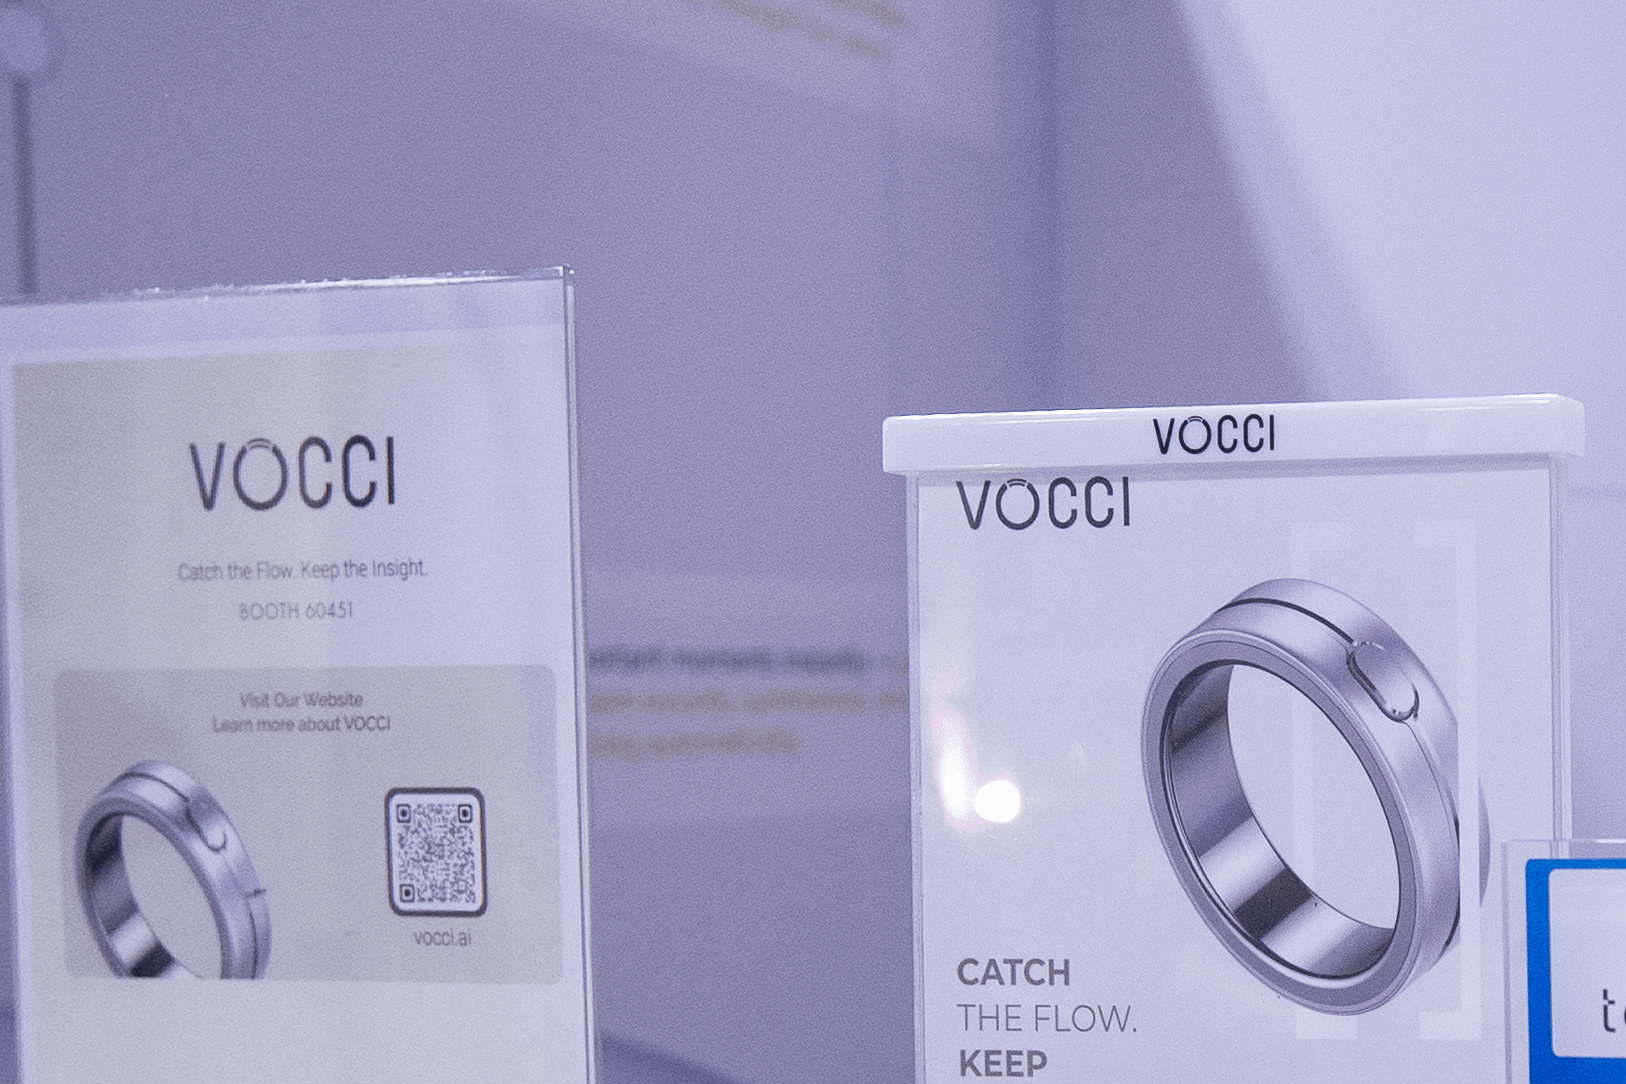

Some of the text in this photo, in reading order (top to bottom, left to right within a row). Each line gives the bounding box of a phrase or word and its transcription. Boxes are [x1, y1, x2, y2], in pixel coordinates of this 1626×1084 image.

[1153, 413, 1276, 455] VOCCI
[190, 434, 396, 511] VOCCI
[955, 475, 1130, 531] VOCCI
[178, 561, 223, 581] Catch
[228, 560, 252, 580] the
[300, 560, 340, 582] Keep
[343, 558, 368, 578] the
[239, 600, 354, 620] BOOTH 60451
[240, 690, 364, 708] Visit Our Website
[213, 714, 391, 733] Learn more about VOCCI
[413, 927, 472, 947] vocci.ai
[956, 957, 1070, 987] CATCH
[956, 1004, 1137, 1033] THE FLOW.
[958, 1049, 1048, 1078] KEEP
